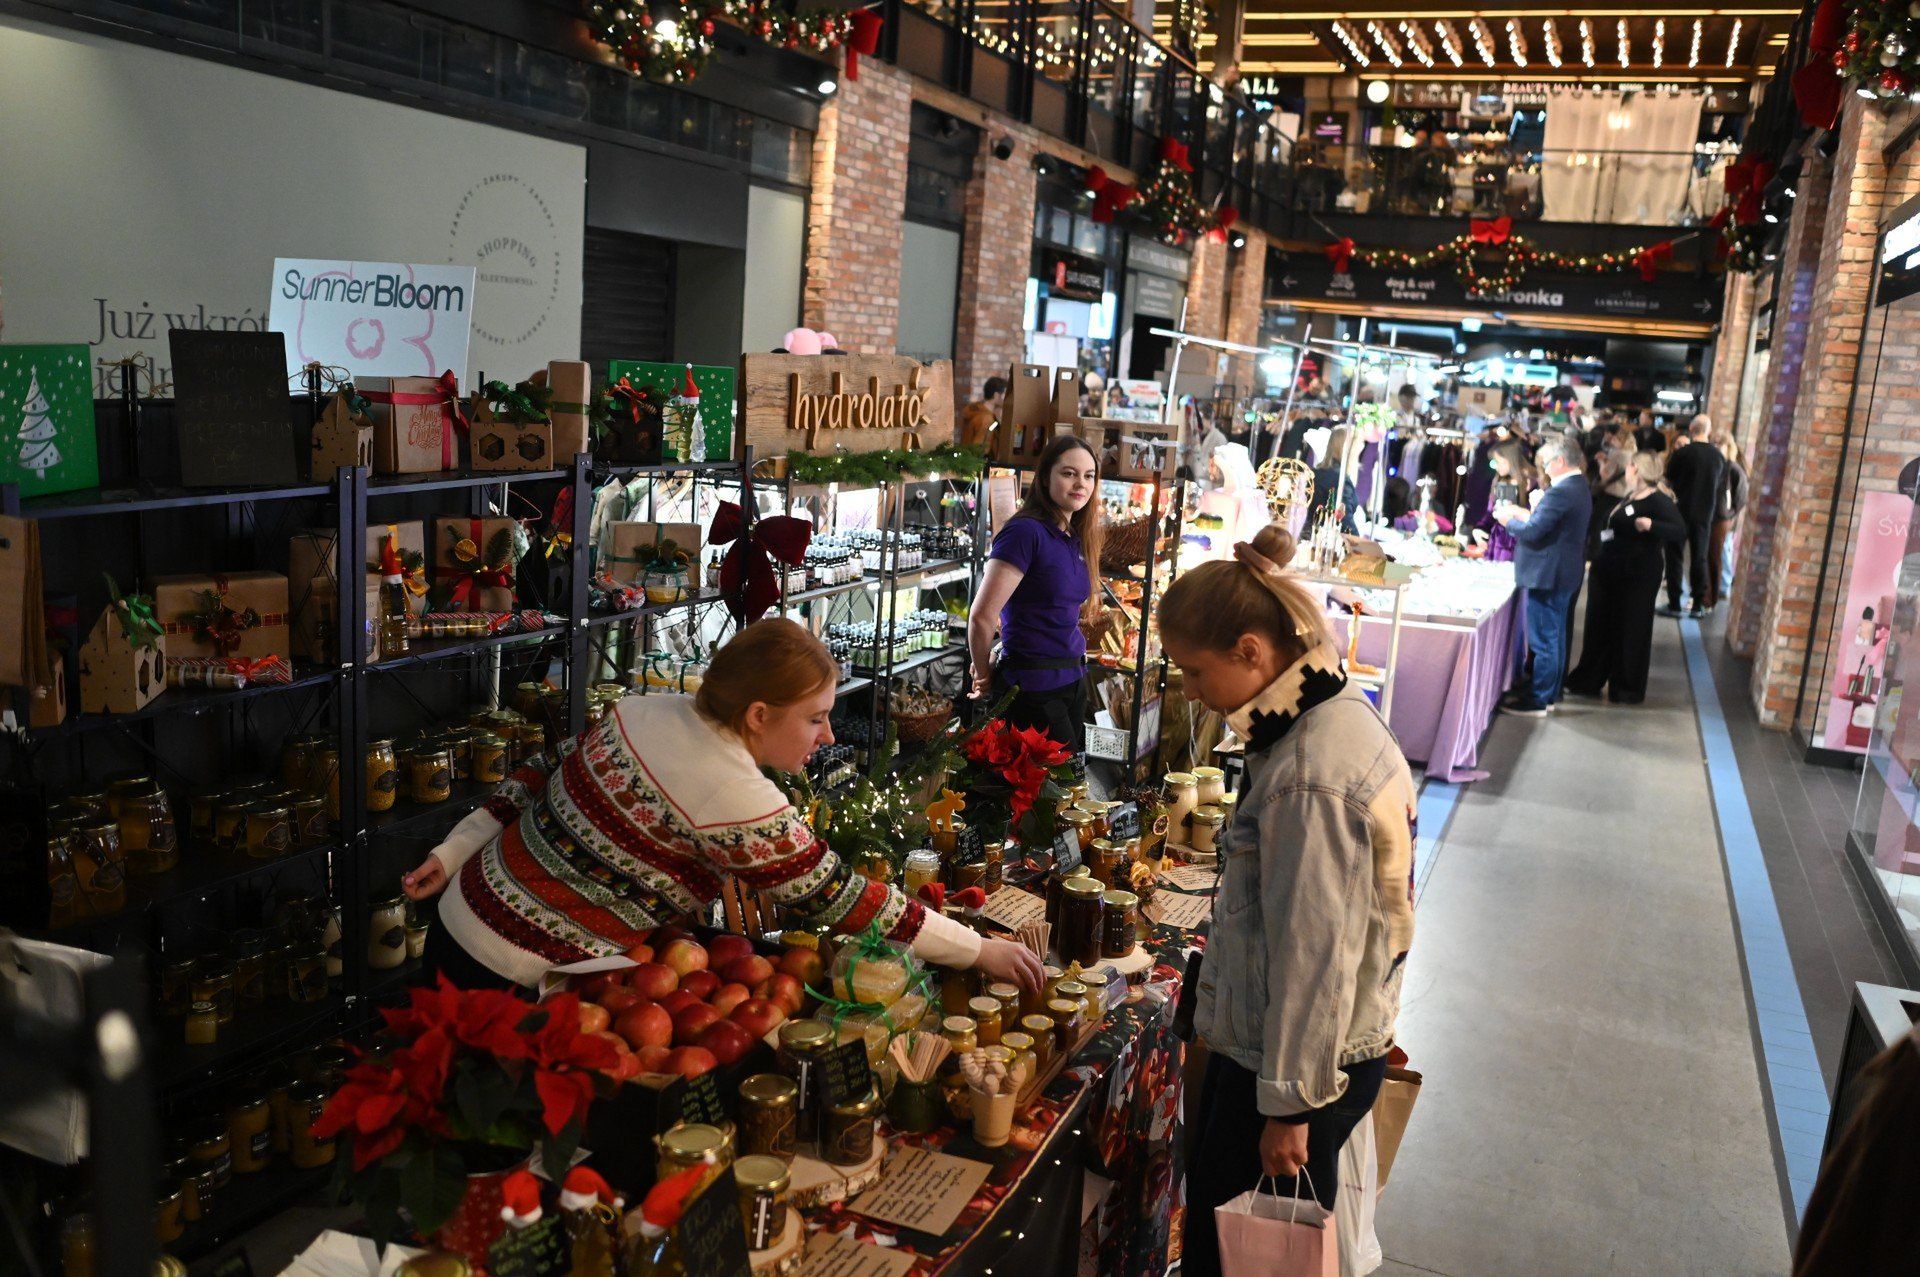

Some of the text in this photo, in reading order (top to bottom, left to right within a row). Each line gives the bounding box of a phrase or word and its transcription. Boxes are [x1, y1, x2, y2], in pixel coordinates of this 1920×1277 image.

[476, 236, 538, 268] SHOPPING
[282, 268, 464, 312] SunnerBloom
[89, 298, 270, 346] Już wkrót
[788, 371, 922, 450] hydrolato
